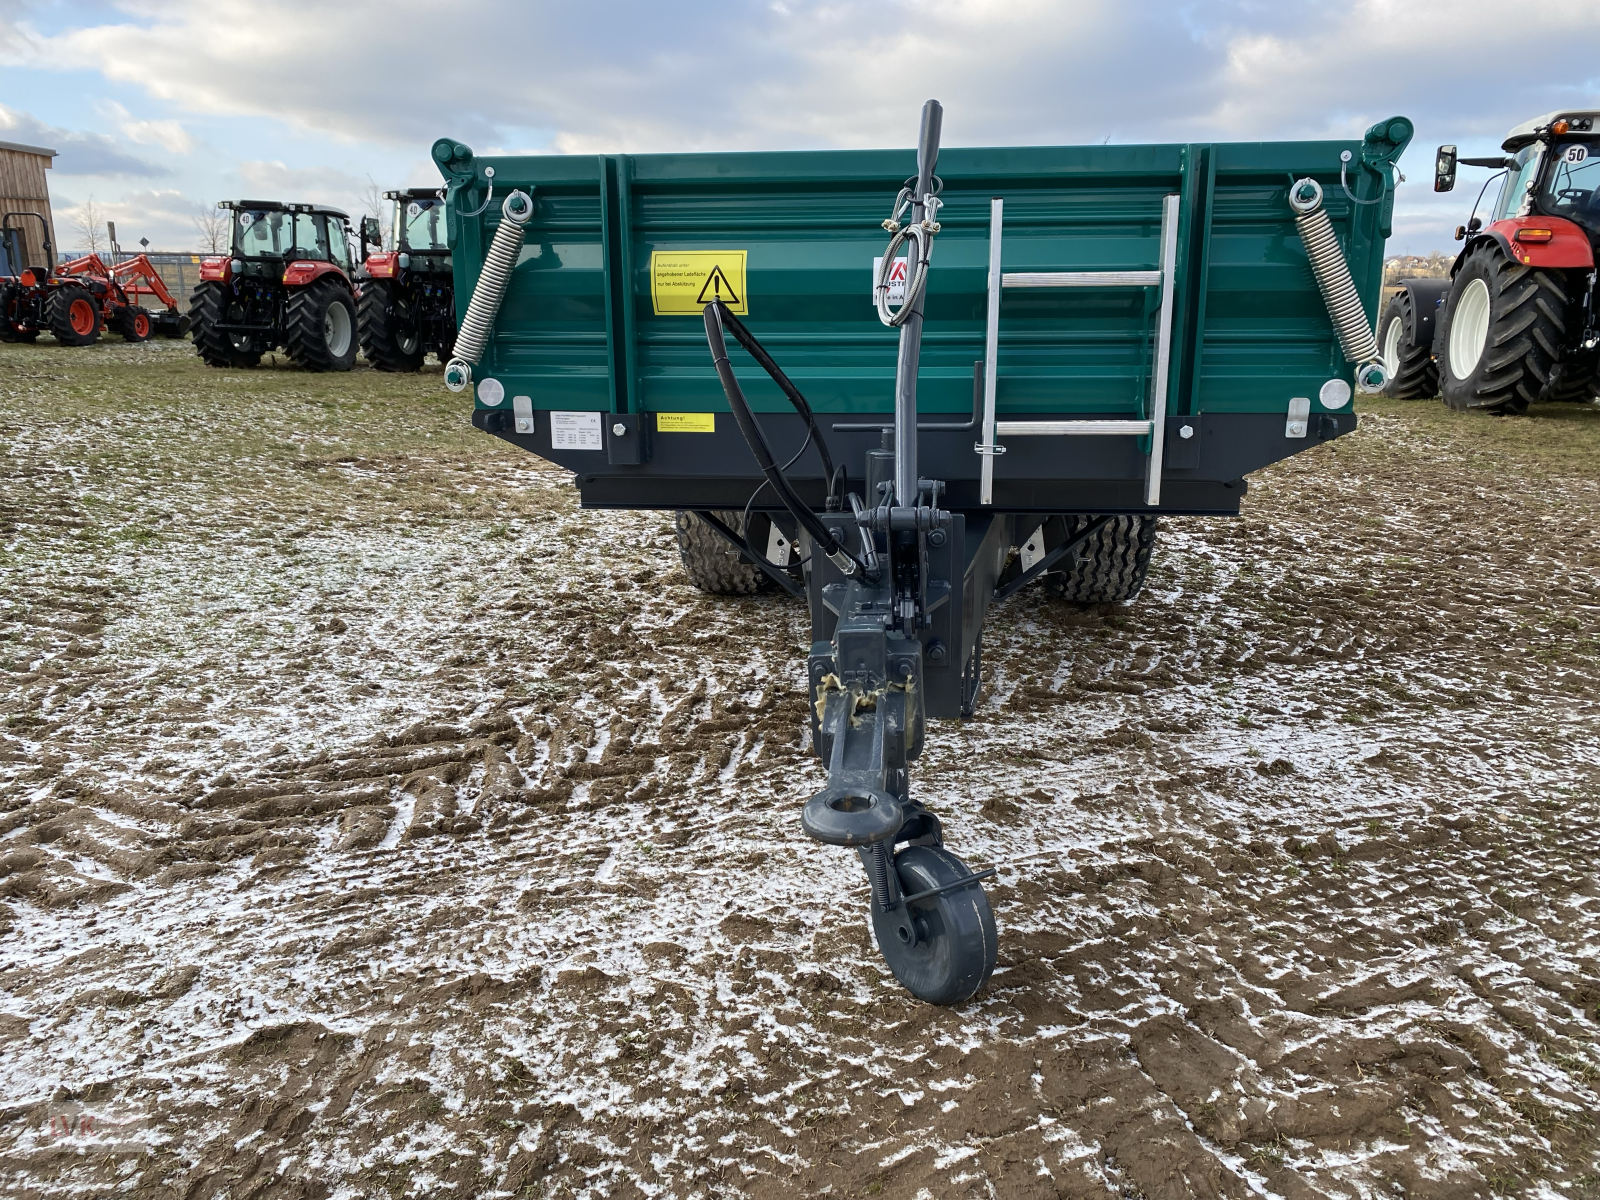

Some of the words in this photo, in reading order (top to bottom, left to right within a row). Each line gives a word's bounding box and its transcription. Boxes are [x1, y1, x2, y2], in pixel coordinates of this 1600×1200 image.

[1568, 148, 1585, 162] 50
[409, 205, 418, 215] 40
[242, 215, 250, 224] 40
